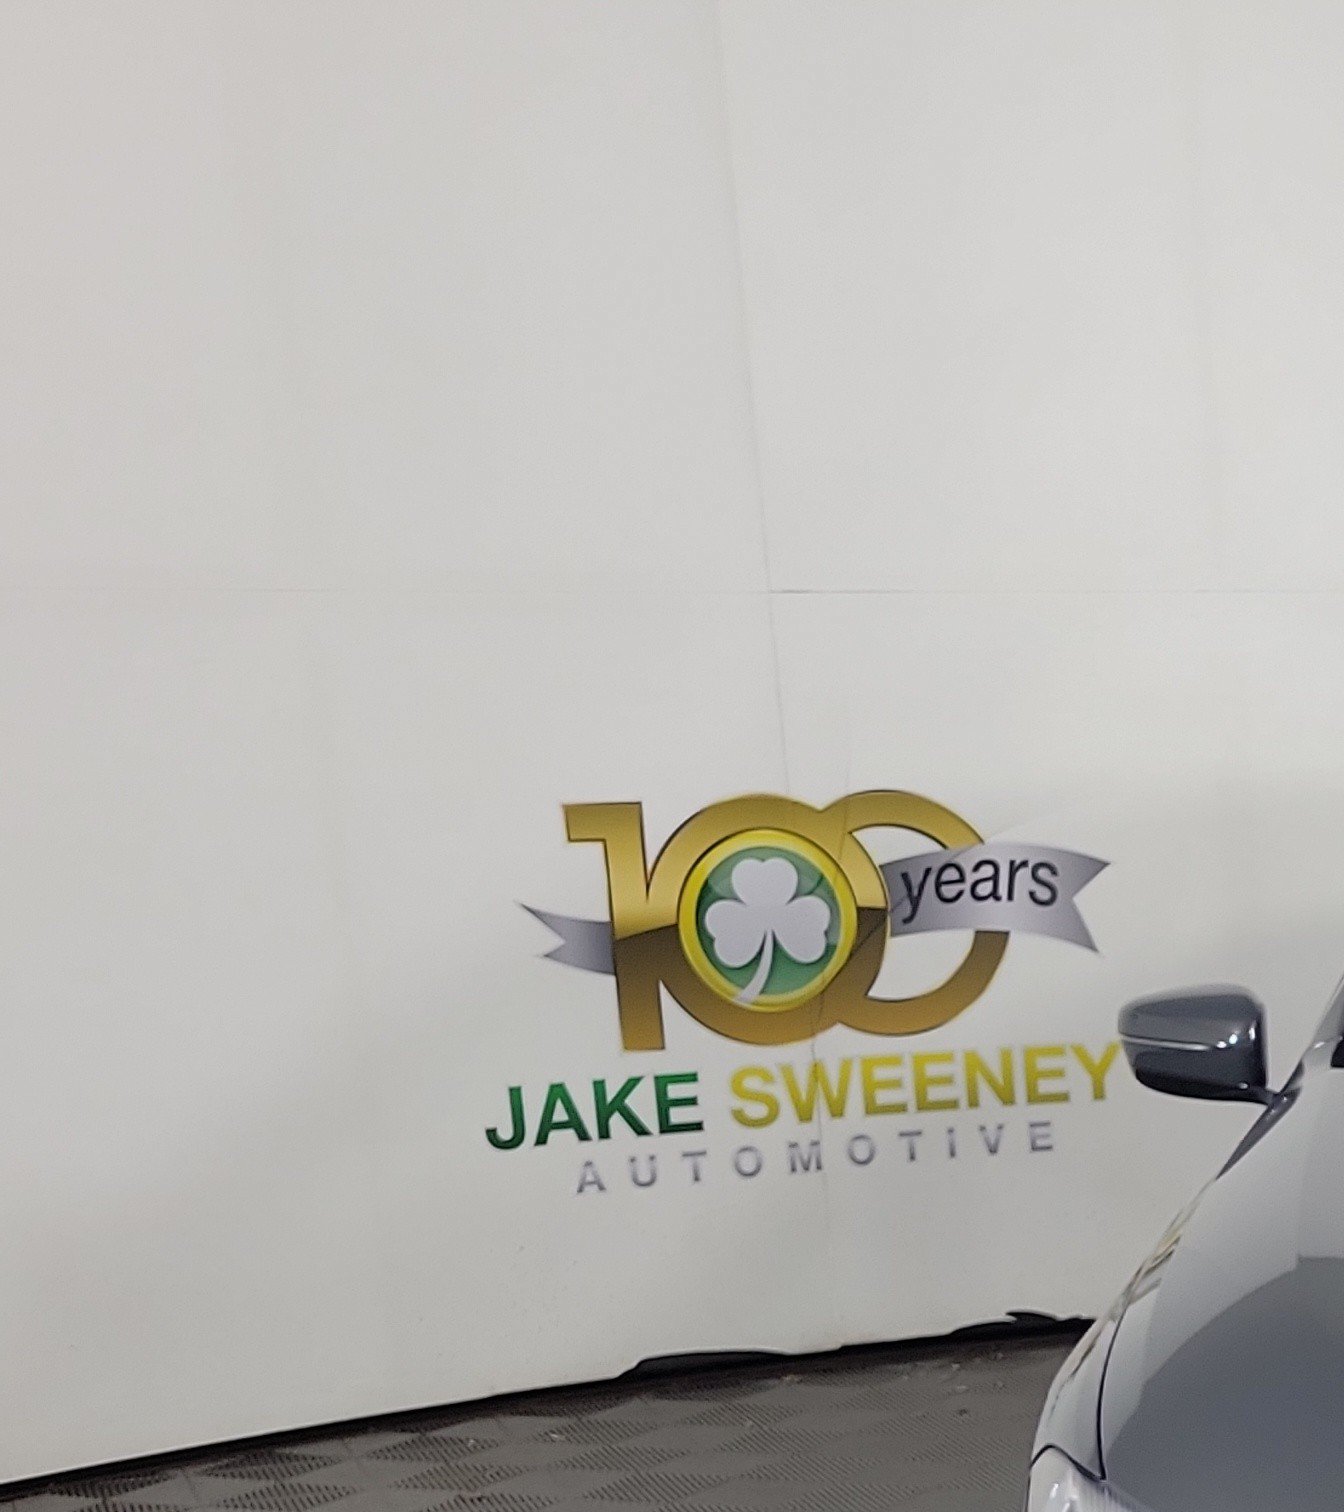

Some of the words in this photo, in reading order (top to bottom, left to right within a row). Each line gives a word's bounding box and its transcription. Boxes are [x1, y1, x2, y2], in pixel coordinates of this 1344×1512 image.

[899, 857, 1060, 924] years
[483, 1071, 705, 1151] JAKE
[728, 1041, 1122, 1131] SWEENEY
[575, 1120, 1054, 1196] AUTOMOTIVE
